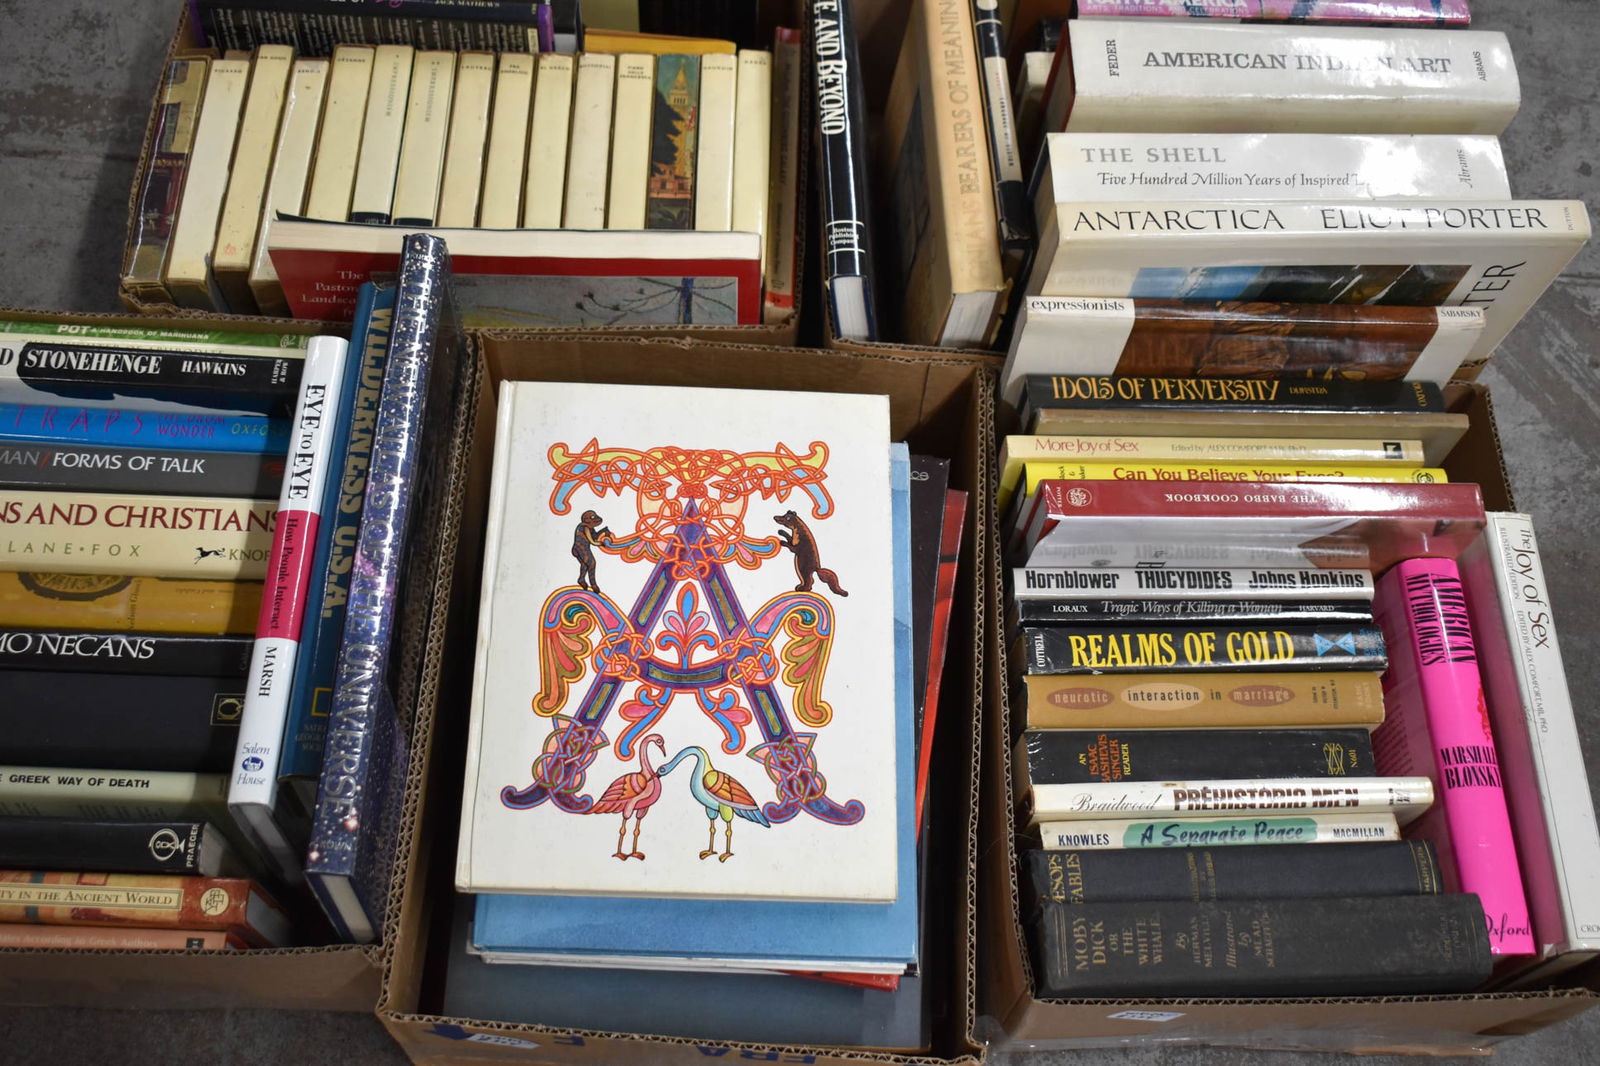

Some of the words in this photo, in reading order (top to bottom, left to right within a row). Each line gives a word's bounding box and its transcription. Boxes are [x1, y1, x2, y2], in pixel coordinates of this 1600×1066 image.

[815, 15, 841, 56] AND
[1105, 39, 1120, 78] FEDER
[1143, 52, 1288, 70] AMERICAN
[1472, 50, 1487, 82] ABRAMS
[817, 58, 847, 136] BEYOND
[948, 80, 970, 105] OF
[952, 108, 981, 195] BEARERS
[1080, 147, 1134, 163] THE
[1146, 147, 1227, 163] SHELL
[1097, 172, 1127, 186] Five
[1129, 171, 1188, 186] Hundred
[1191, 172, 1243, 186] Million
[1244, 173, 1281, 187] Years
[1285, 173, 1297, 187] of
[1301, 173, 1350, 188] Inspired
[1456, 149, 1473, 188] Abrams
[1073, 210, 1286, 231] ANTARCTICA
[1425, 208, 1548, 229] PORTER
[337, 270, 365, 281] The
[1031, 299, 1125, 312] expressionists
[1440, 310, 1482, 318] SABARSKY
[57, 324, 92, 335] POT
[159, 331, 209, 340] MARIHUANA
[24, 348, 163, 375] STONEHENGE
[180, 360, 247, 376] HAWKINS
[270, 358, 284, 385] HARPER
[1051, 376, 1115, 400] IDOLS
[1116, 377, 1146, 400] OF
[1149, 378, 1280, 402] PERVERSITY
[15, 404, 144, 436] TRAPS
[299, 383, 327, 430] EYE
[340, 308, 393, 514] WILDERNESS
[157, 423, 215, 440] WONDER
[300, 431, 313, 450] TO
[1035, 438, 1075, 451] More
[1076, 438, 1100, 455] Joy
[1113, 439, 1139, 452] Sex
[52, 452, 123, 470] FORMS
[128, 455, 156, 471] OF
[160, 457, 206, 474] TALK
[287, 451, 315, 501] EYE
[1113, 466, 1147, 481] Can
[1151, 467, 1182, 481] You
[1186, 468, 1248, 482] Believe
[1252, 470, 1292, 482] Your
[1164, 492, 1240, 504] COOKBOOK
[1244, 493, 1287, 504] BABBO
[1291, 494, 1317, 504] THE
[25, 502, 98, 526] AND
[284, 517, 299, 542] How
[1519, 528, 1533, 549] The
[276, 546, 294, 582] People
[323, 525, 358, 618] U.S.A.
[1511, 545, 1536, 581] Joy
[1025, 570, 1120, 589] Hornblower
[1135, 570, 1233, 590] THUCYDIDES
[1248, 570, 1296, 590] Johns
[1299, 571, 1365, 589] Hopkins
[270, 585, 288, 630] Interact
[1052, 604, 1089, 613] LORAUX
[1101, 600, 1139, 617] Tragic
[1141, 601, 1172, 617] Ways
[1172, 601, 1185, 616] of
[1186, 601, 1226, 617] Killing
[1238, 601, 1283, 614] Woman
[1299, 604, 1335, 612] HARVARD
[1523, 583, 1547, 608] of
[1405, 572, 1447, 666] MYTHOLOGIES
[1430, 573, 1478, 665] AMERICAN
[1528, 610, 1551, 650] Sex
[36, 634, 156, 660] NECANS
[1068, 632, 1177, 668] REALMS
[1183, 632, 1217, 665] OF
[1225, 630, 1295, 664] GOLD
[1517, 609, 1527, 635] EDITED
[1524, 644, 1534, 663] ALEX
[1034, 633, 1045, 668] COTTRELL
[258, 646, 279, 697] MARSH
[1054, 691, 1109, 704] neurotic
[1127, 689, 1200, 702] interaction
[1210, 688, 1222, 701] in
[1233, 688, 1291, 703] marriage
[319, 642, 381, 820] UNIVERSE
[241, 742, 271, 756] Salem
[1078, 753, 1087, 766] AN
[1087, 743, 1100, 776] ISAAC
[1109, 739, 1123, 781] SINGER
[1121, 743, 1131, 776] READER
[9, 774, 51, 786] GREEK
[57, 775, 85, 787] WAY
[87, 776, 105, 788] OF
[109, 777, 151, 789] DEATH
[236, 772, 267, 786] House
[1443, 764, 1504, 789] BLONSKY
[1069, 792, 1163, 812] Braidwood
[185, 823, 200, 869] PRAEGER
[1057, 833, 1110, 847] KNOWLES
[1139, 824, 1155, 846] A
[1161, 823, 1247, 847] Separate
[1253, 820, 1304, 842] Peace
[1332, 827, 1385, 838] MACMILLAN
[1066, 853, 1084, 905] FABLES
[18, 890, 32, 900] IN
[37, 891, 60, 901] THE
[1072, 912, 1089, 971] MOBY
[1090, 920, 1107, 965] DICK
[1109, 933, 1119, 952] OR
[1122, 926, 1135, 956] THE
[1135, 918, 1149, 966] WHITE
[1151, 915, 1163, 965] WHALE
